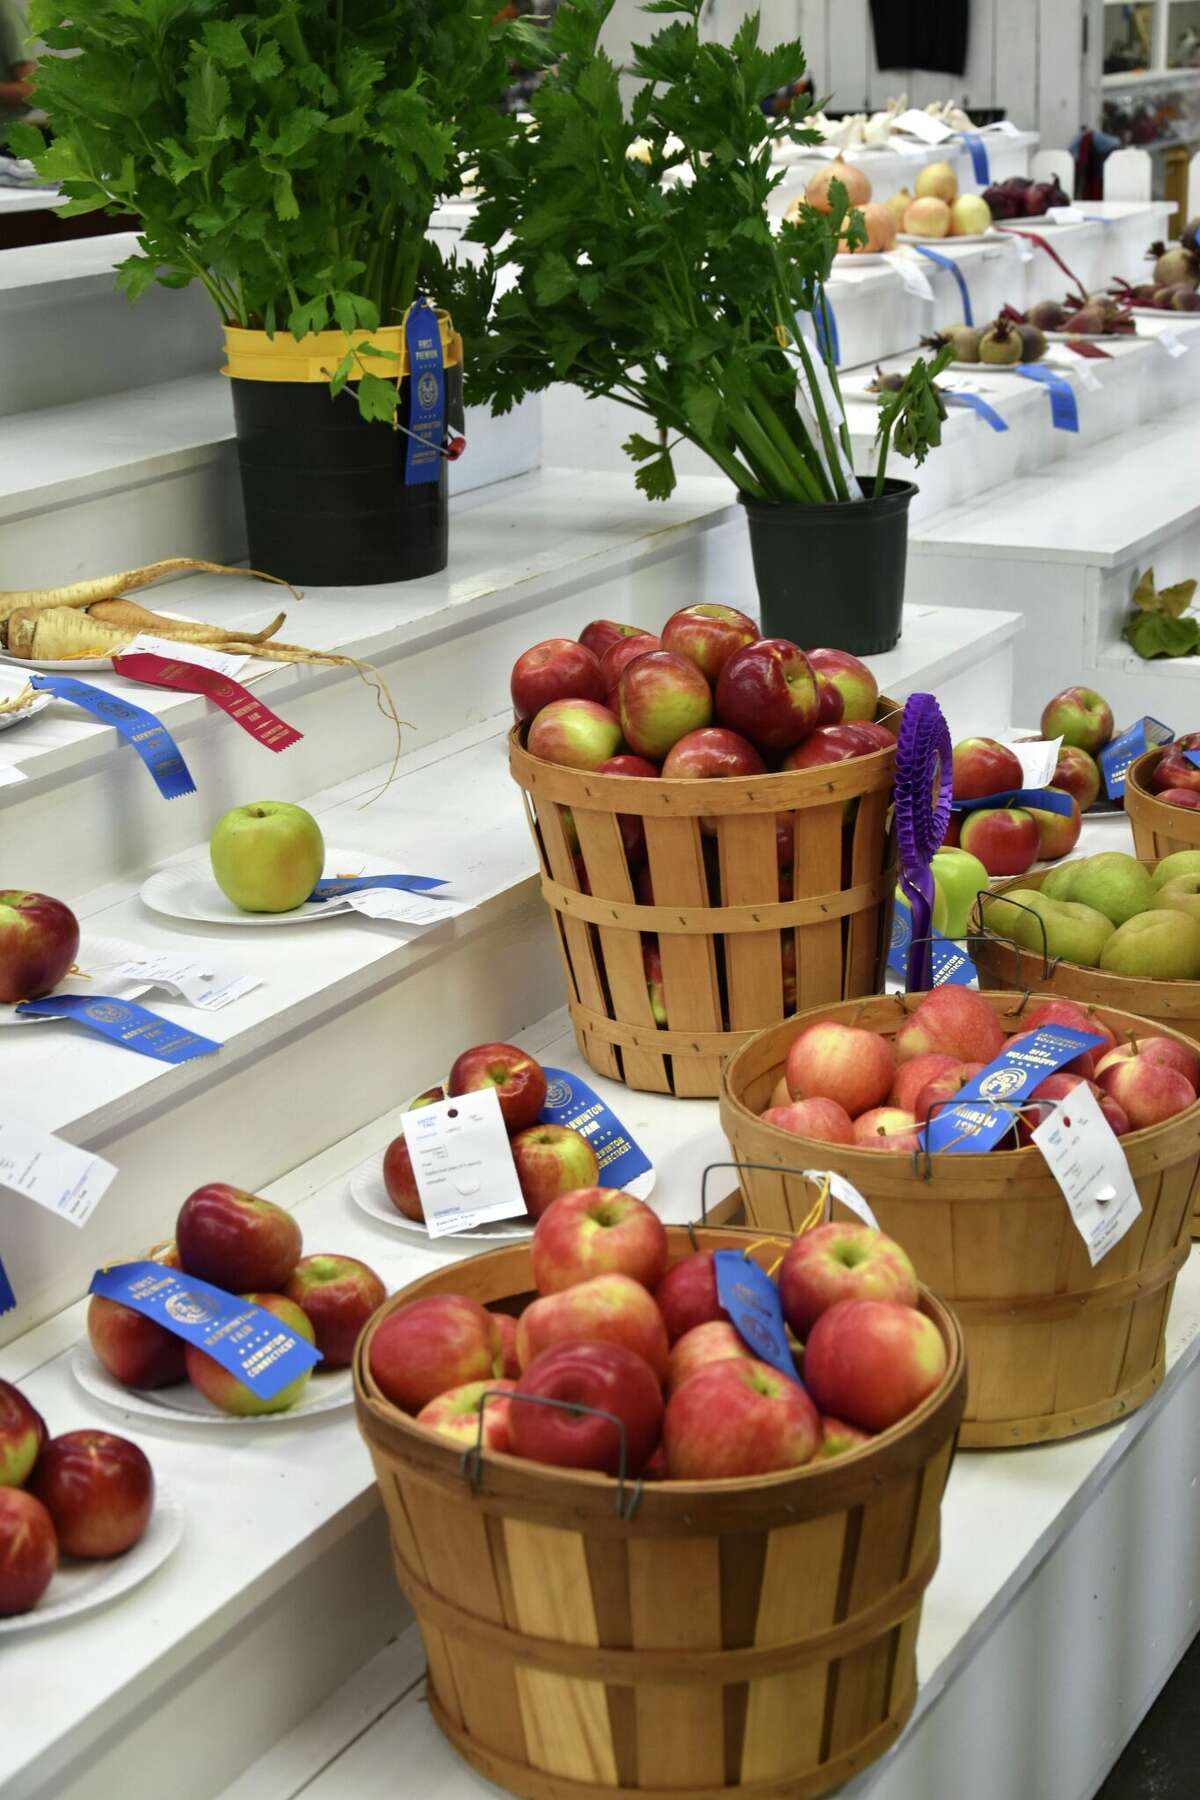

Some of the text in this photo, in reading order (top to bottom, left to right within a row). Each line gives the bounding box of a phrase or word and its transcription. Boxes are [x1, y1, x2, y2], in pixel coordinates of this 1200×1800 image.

[1006, 1051, 1059, 1067] HARWINTON
[1029, 1049, 1051, 1058] FAIR
[565, 1104, 605, 1129] ARWINTON
[579, 1120, 601, 1137] FAIR
[241, 1333, 287, 1369] HARWINTON
[247, 1338, 296, 1378] CONNECTICUT
